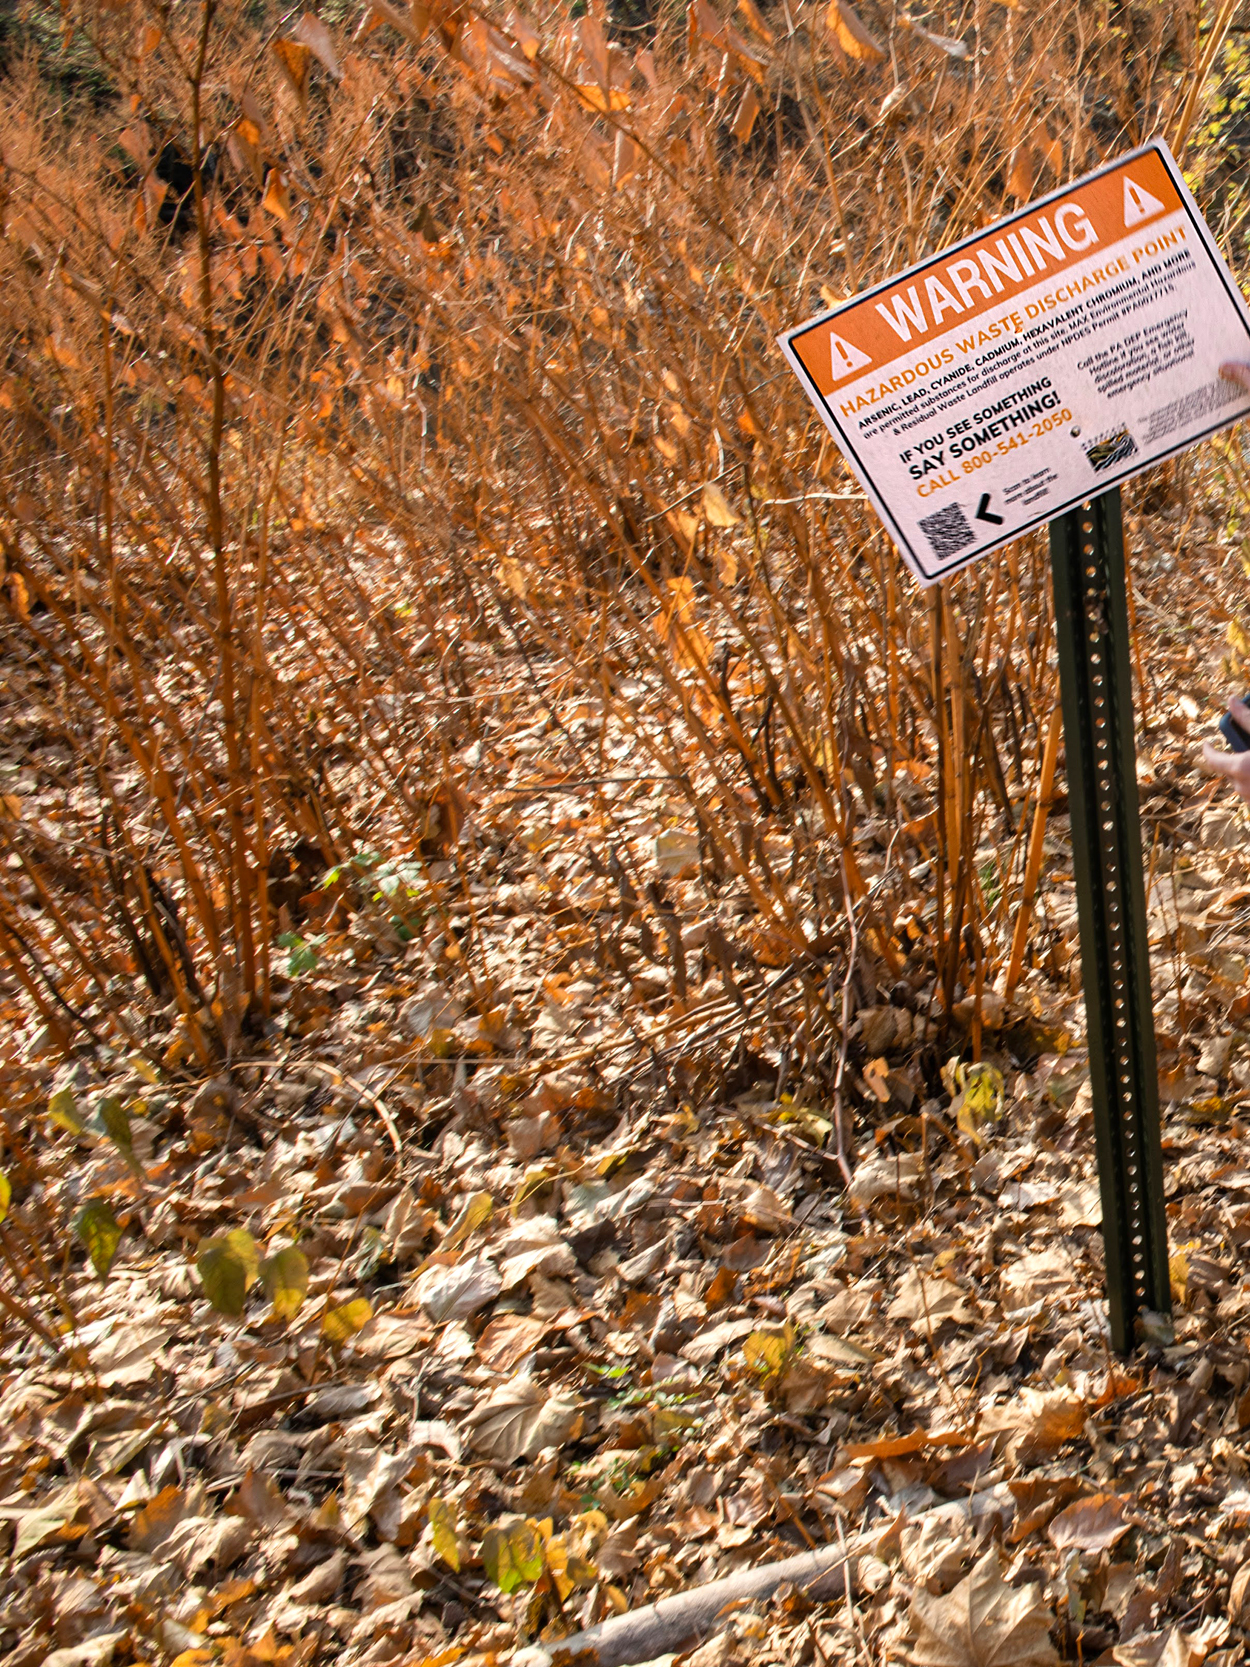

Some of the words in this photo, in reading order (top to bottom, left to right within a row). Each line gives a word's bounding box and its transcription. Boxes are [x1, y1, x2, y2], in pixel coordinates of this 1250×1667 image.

[838, 347, 955, 418] HAZARDOUS
[954, 310, 1024, 355] WASTE
[1023, 254, 1131, 321] DISCHARGE
[1130, 223, 1187, 265] POINT
[873, 202, 1100, 343] WARNING
[858, 401, 903, 431] ARSENIC,
[900, 387, 931, 407] LEAD,
[929, 362, 976, 391] CYANIDE,
[974, 337, 1023, 367] CADMIUM,
[1021, 303, 1084, 342] HEXAVALENT
[1085, 275, 1141, 309] CHROMIUM,
[1141, 263, 1163, 281] AND
[1162, 249, 1191, 270] MORE
[862, 427, 879, 440] are
[877, 403, 920, 434] permitted
[919, 380, 967, 410] substances
[966, 372, 980, 384] for
[980, 351, 1022, 377] discharge
[1021, 344, 1033, 355] at
[1031, 336, 1050, 350] this
[1067, 313, 1090, 331] MAX
[1088, 282, 1150, 321] Environmental
[1149, 260, 1197, 290] Hazardous
[892, 427, 902, 436] &
[899, 406, 938, 432] Residual
[936, 393, 966, 412] Waste
[964, 374, 999, 398] Landfill
[998, 356, 1036, 380] operates
[1035, 342, 1060, 361] under
[1060, 326, 1092, 348] NPDES
[1090, 311, 1120, 332] Permit
[1076, 355, 1095, 371] Call
[1093, 350, 1109, 363] the
[1108, 341, 1123, 355] PA
[1123, 331, 1141, 348] DEP
[1142, 308, 1188, 338] Emergency
[1088, 356, 1120, 376] Hotline
[1119, 349, 1127, 360] if
[1127, 342, 1144, 360] you
[1144, 334, 1160, 348] see
[898, 448, 914, 464] IF
[912, 432, 945, 455] YOU
[945, 417, 973, 440] SEE
[972, 375, 1053, 426] SOMETHING
[908, 449, 946, 481] SAY
[948, 389, 1062, 459] SOMETHING!
[915, 468, 961, 498] CALL
[960, 407, 1073, 474] 800-541-2050
